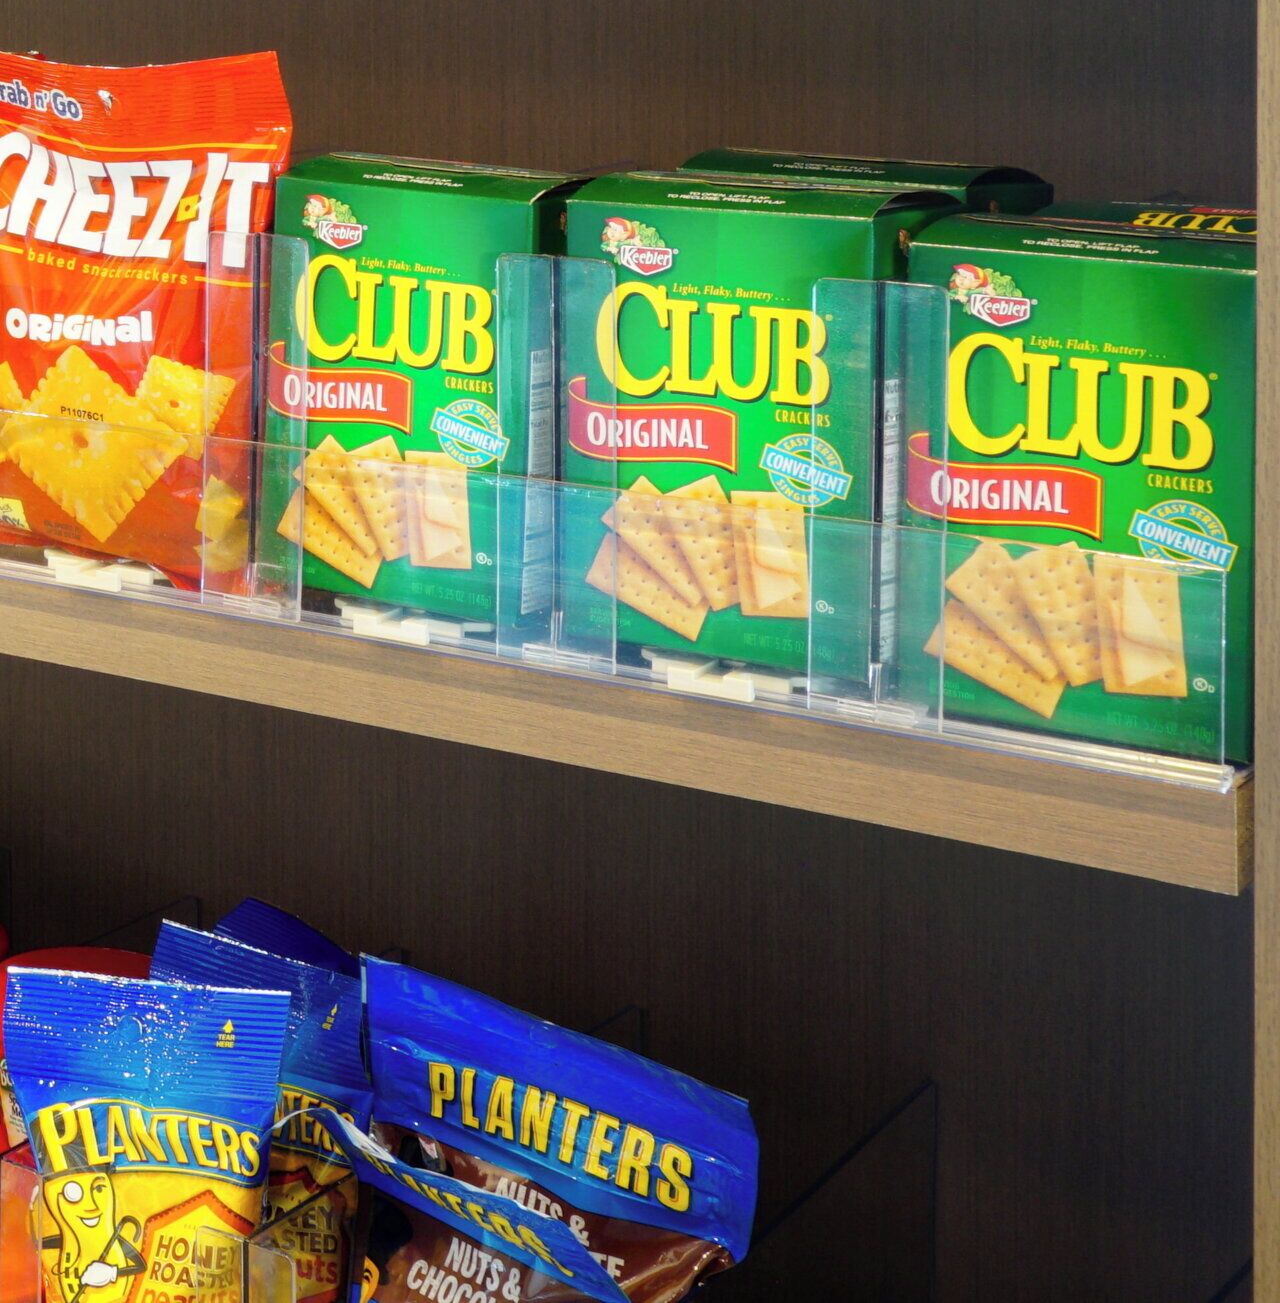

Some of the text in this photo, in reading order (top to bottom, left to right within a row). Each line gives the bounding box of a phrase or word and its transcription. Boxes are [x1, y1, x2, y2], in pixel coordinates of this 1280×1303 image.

[35, 90, 49, 108] n'
[52, 92, 81, 119] Go
[319, 223, 361, 242] Keebler
[27, 247, 188, 285] baked snack crackers
[361, 257, 411, 272] Light, Flaky,
[620, 249, 672, 269] Keebler
[672, 283, 732, 300] Light, Flaky,
[970, 295, 1030, 318] Keebler
[295, 254, 496, 373] CLUB
[596, 281, 832, 405] CLUB
[1030, 335, 1099, 354] Light, Flaky,
[283, 374, 387, 413] ORIGINAL
[444, 376, 494, 394] CRACKERS
[947, 331, 1215, 471] CLUB
[436, 417, 504, 452] CONVENIENT
[586, 411, 709, 451] ORIGINAL
[766, 451, 847, 493] CONVENIENT
[1146, 473, 1214, 495] CRACKERS
[929, 470, 1069, 515] ORIGINAL
[1135, 517, 1230, 565] CONVENIENT
[38, 1102, 261, 1178] PLANTERS
[427, 1060, 693, 1214] PLANTERS
[494, 1175, 591, 1248] NUTS &
[155, 1234, 242, 1270] HONEY
[444, 1236, 523, 1303] NUTS &
[149, 1260, 239, 1290] ROASTED
